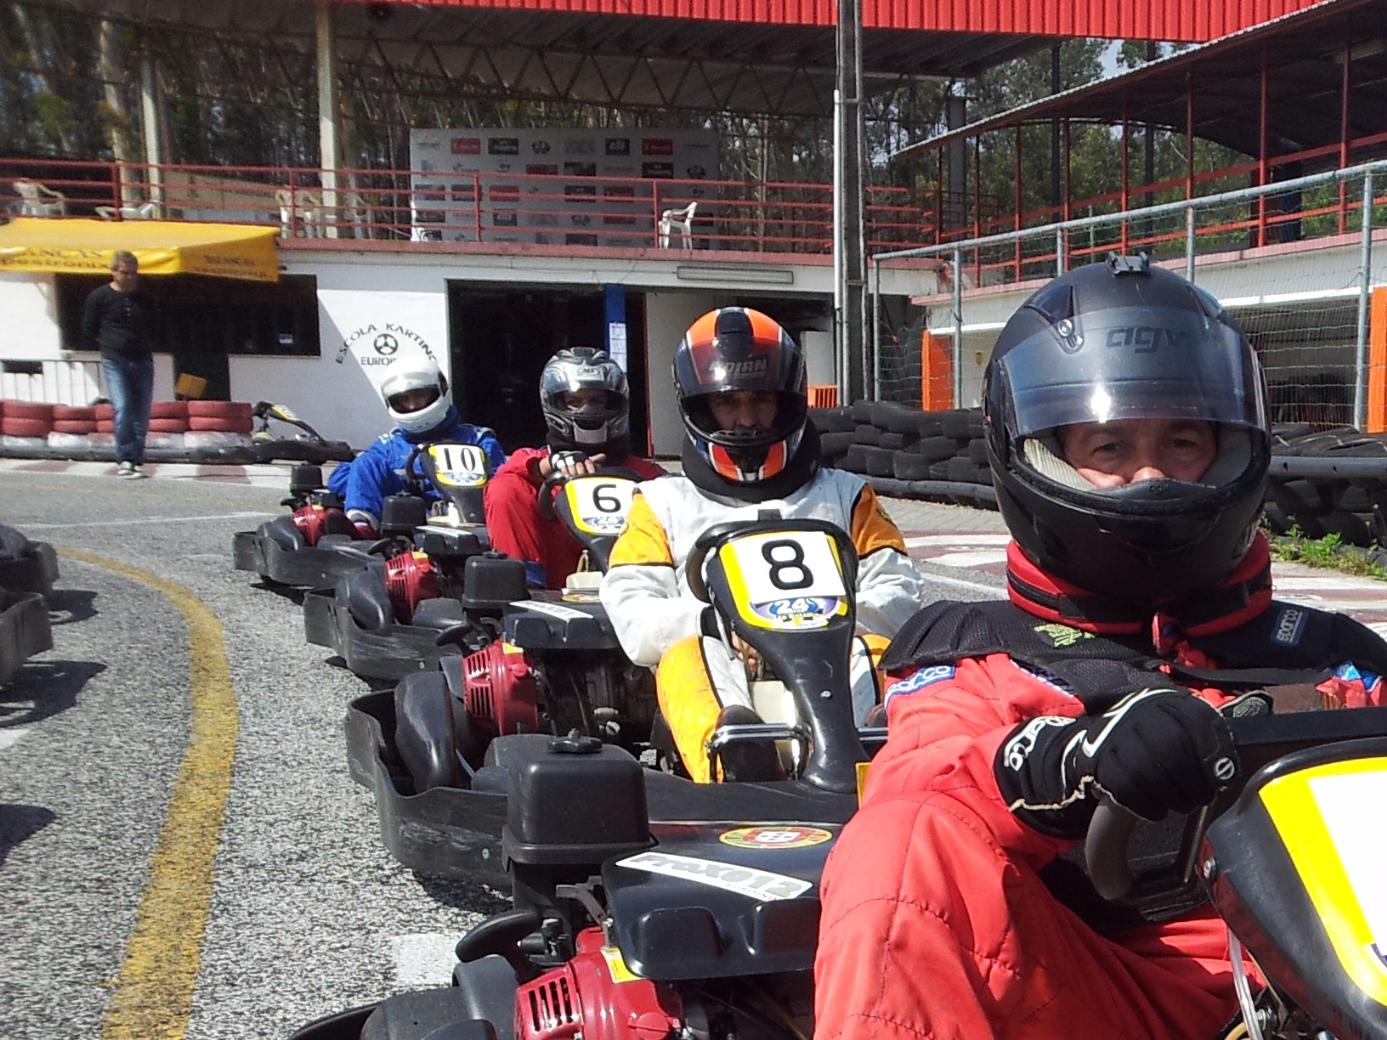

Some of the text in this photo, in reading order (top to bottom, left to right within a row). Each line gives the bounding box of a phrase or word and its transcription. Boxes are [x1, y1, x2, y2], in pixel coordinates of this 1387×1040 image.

[335, 323, 377, 365] ESCOLA
[1105, 326, 1188, 354] agv
[443, 440, 477, 472] 10
[592, 483, 622, 514] 6
[761, 538, 814, 591] 8
